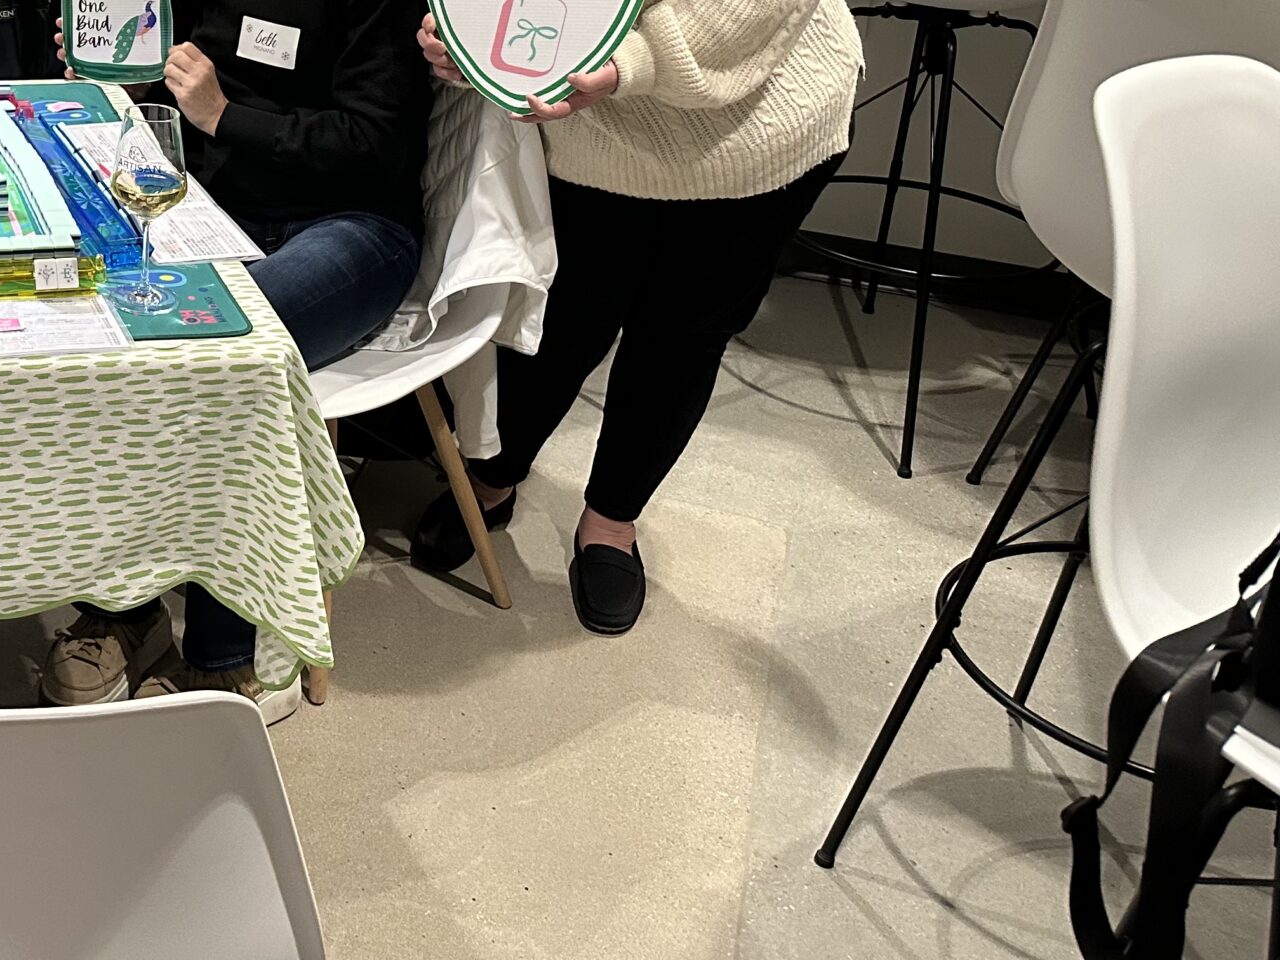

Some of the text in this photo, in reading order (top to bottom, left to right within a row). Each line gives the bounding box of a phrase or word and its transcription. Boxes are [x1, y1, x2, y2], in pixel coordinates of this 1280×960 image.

[76, 14, 112, 32] Bird
[76, 31, 112, 48] Bam
[255, 29, 277, 48] beth
[118, 158, 161, 173] ARTISAN
[63, 268, 71, 279] E
